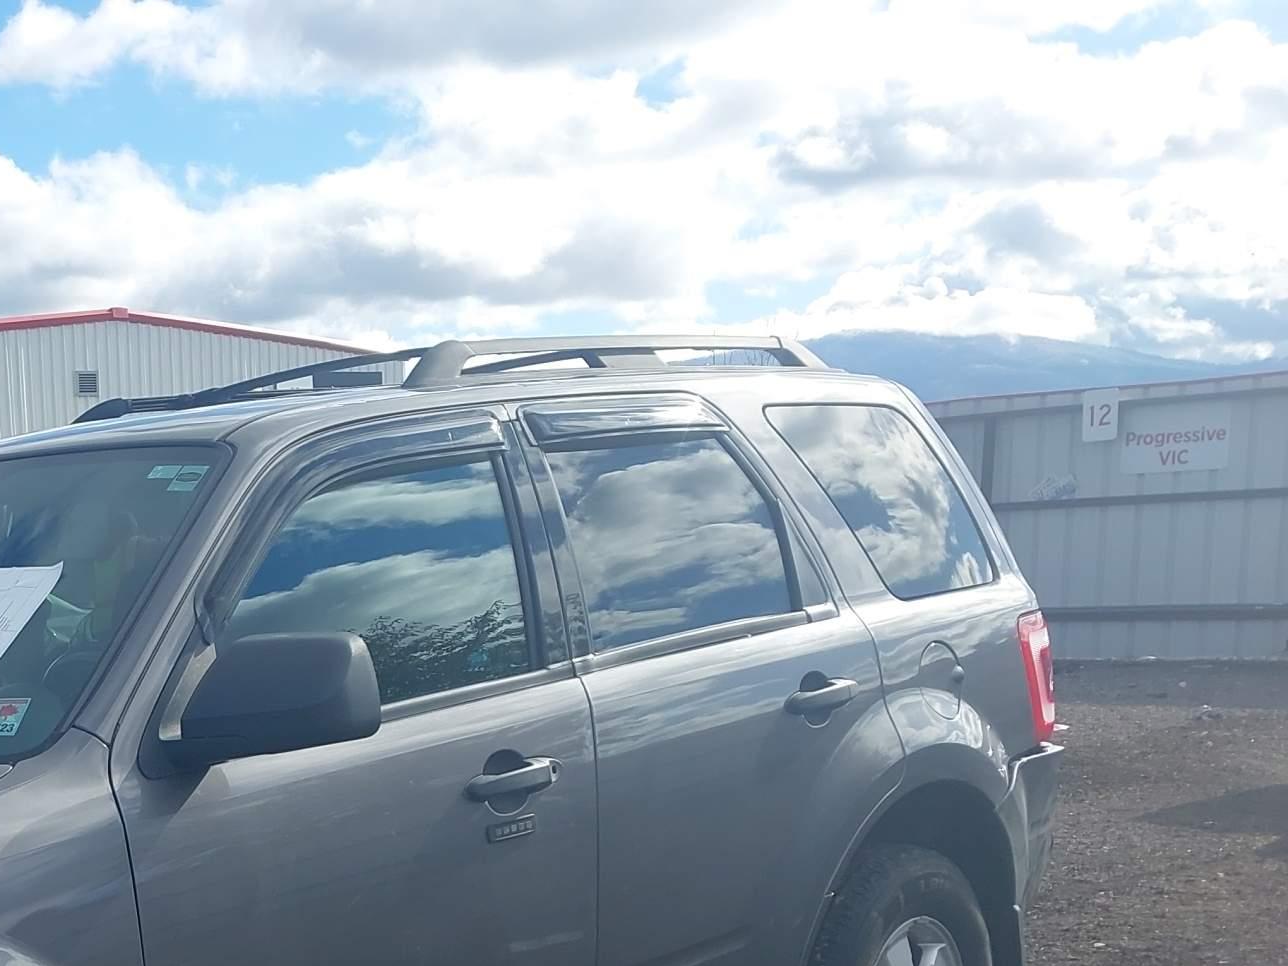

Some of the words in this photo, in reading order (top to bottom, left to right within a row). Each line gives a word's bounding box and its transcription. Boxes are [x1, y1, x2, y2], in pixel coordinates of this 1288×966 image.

[1089, 404, 1112, 427] 12
[1125, 425, 1227, 448] Progressive
[1158, 449, 1190, 466] VIC
